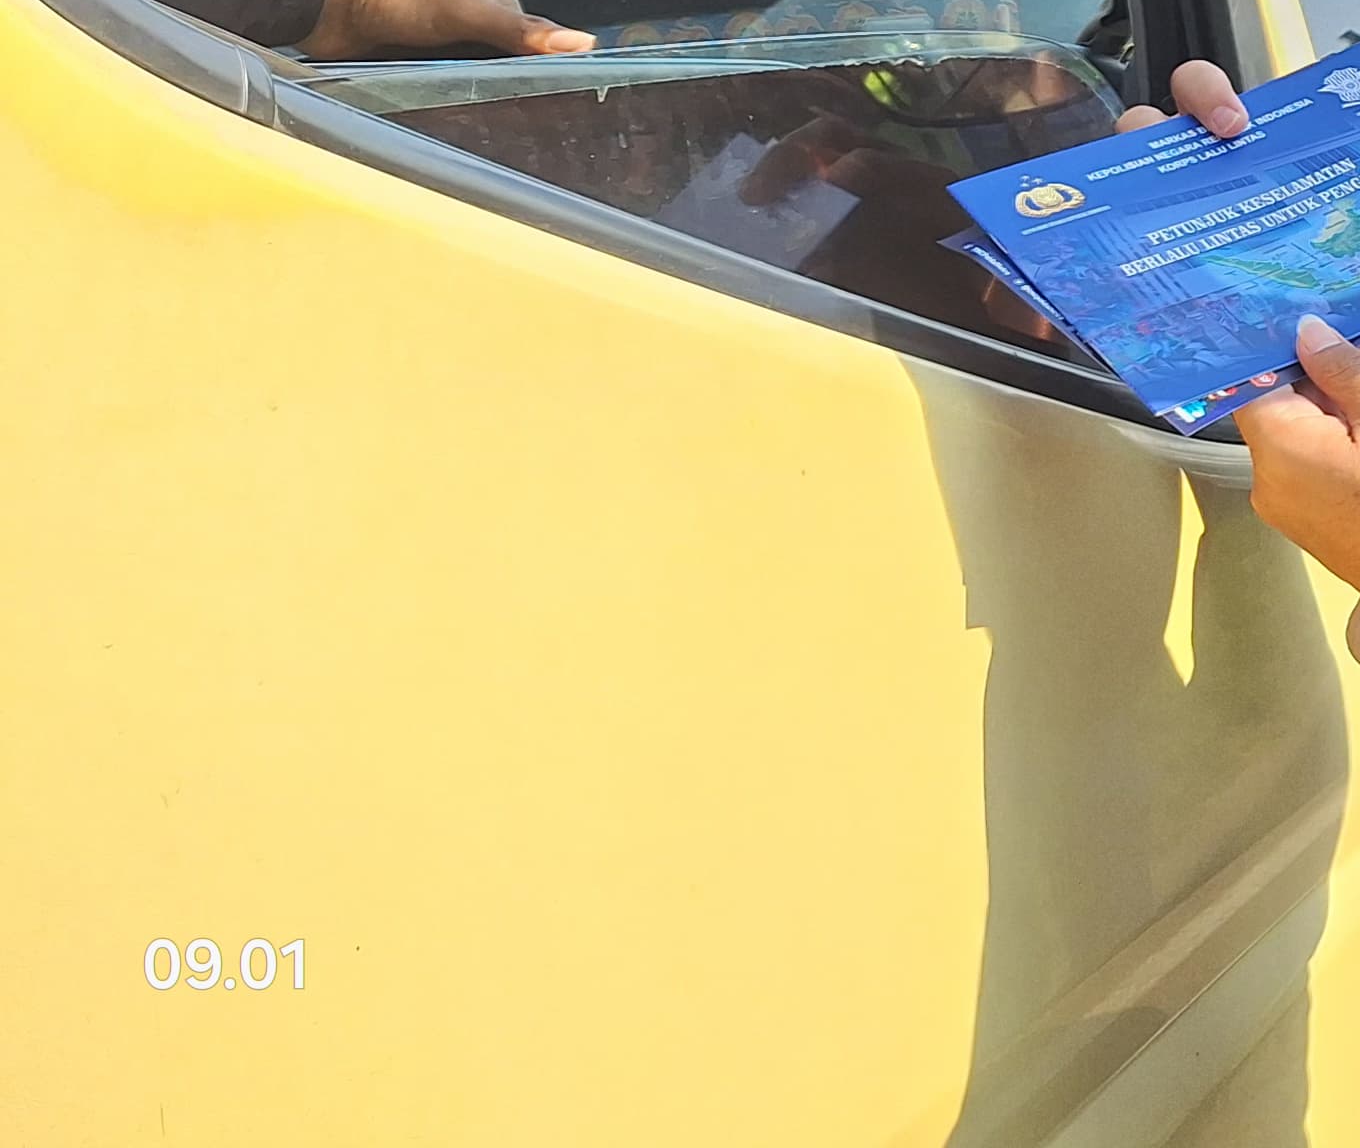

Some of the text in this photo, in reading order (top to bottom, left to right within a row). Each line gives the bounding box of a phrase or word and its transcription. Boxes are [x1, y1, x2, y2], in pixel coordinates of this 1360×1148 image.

[1255, 98, 1314, 126] INDONESIA
[1149, 129, 1197, 149] MARKAS
[1157, 155, 1199, 174] KORPS
[1200, 145, 1227, 163] LALU
[1226, 130, 1266, 152] LINTAS
[1087, 141, 1201, 181] KEPOLISIAN NEGARA
[1147, 156, 1357, 245] PETUNJUK KESELAMATAN
[1120, 240, 1203, 277] BERLALU
[1202, 220, 1263, 252] LINTAS
[1262, 198, 1322, 228] UNTUK
